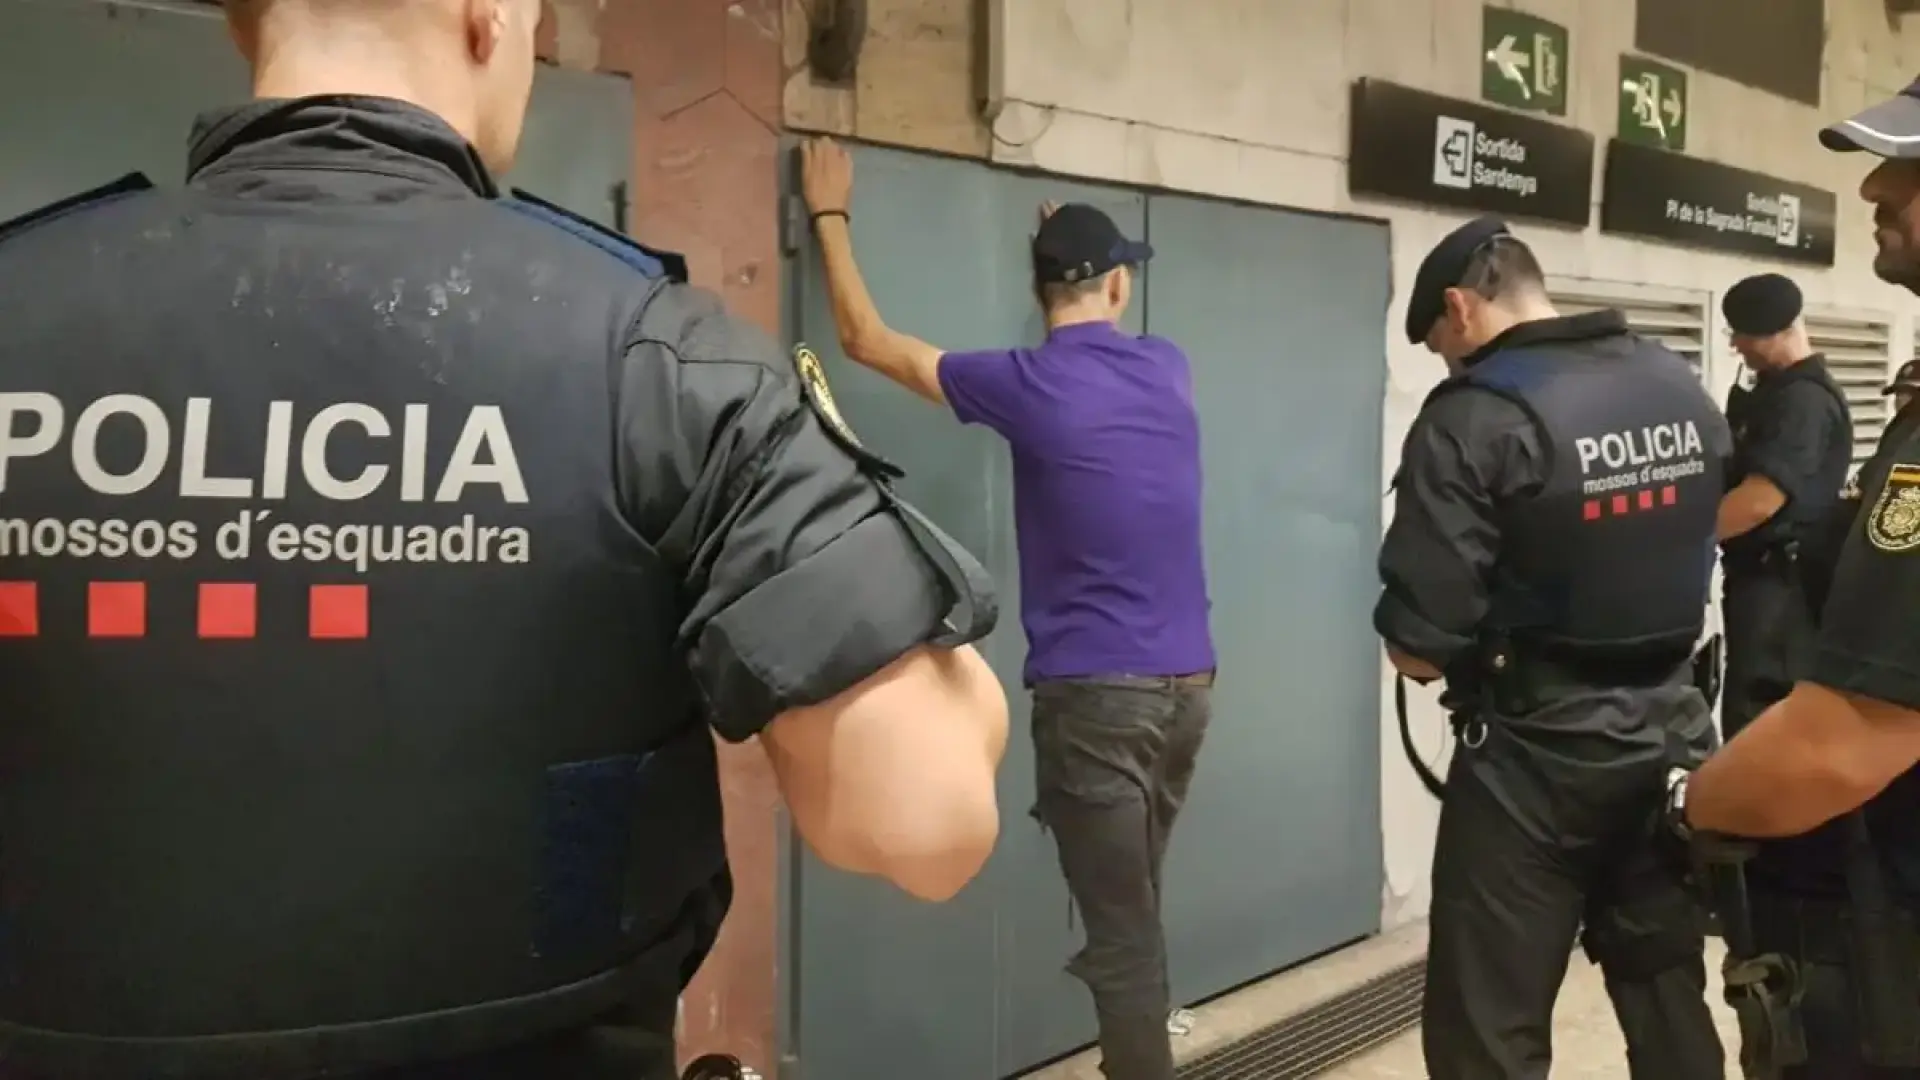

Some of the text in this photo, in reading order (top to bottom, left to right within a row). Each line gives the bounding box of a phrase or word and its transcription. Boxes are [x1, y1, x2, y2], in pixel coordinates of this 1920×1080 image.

[1475, 131, 1526, 163] Sortida
[1473, 161, 1537, 197] Sardenya
[1679, 202, 1693, 223] de
[1695, 205, 1704, 225] la
[0, 391, 530, 504] POLICIA
[1575, 420, 1704, 474] POLICIA
[1583, 472, 1639, 495] mossos
